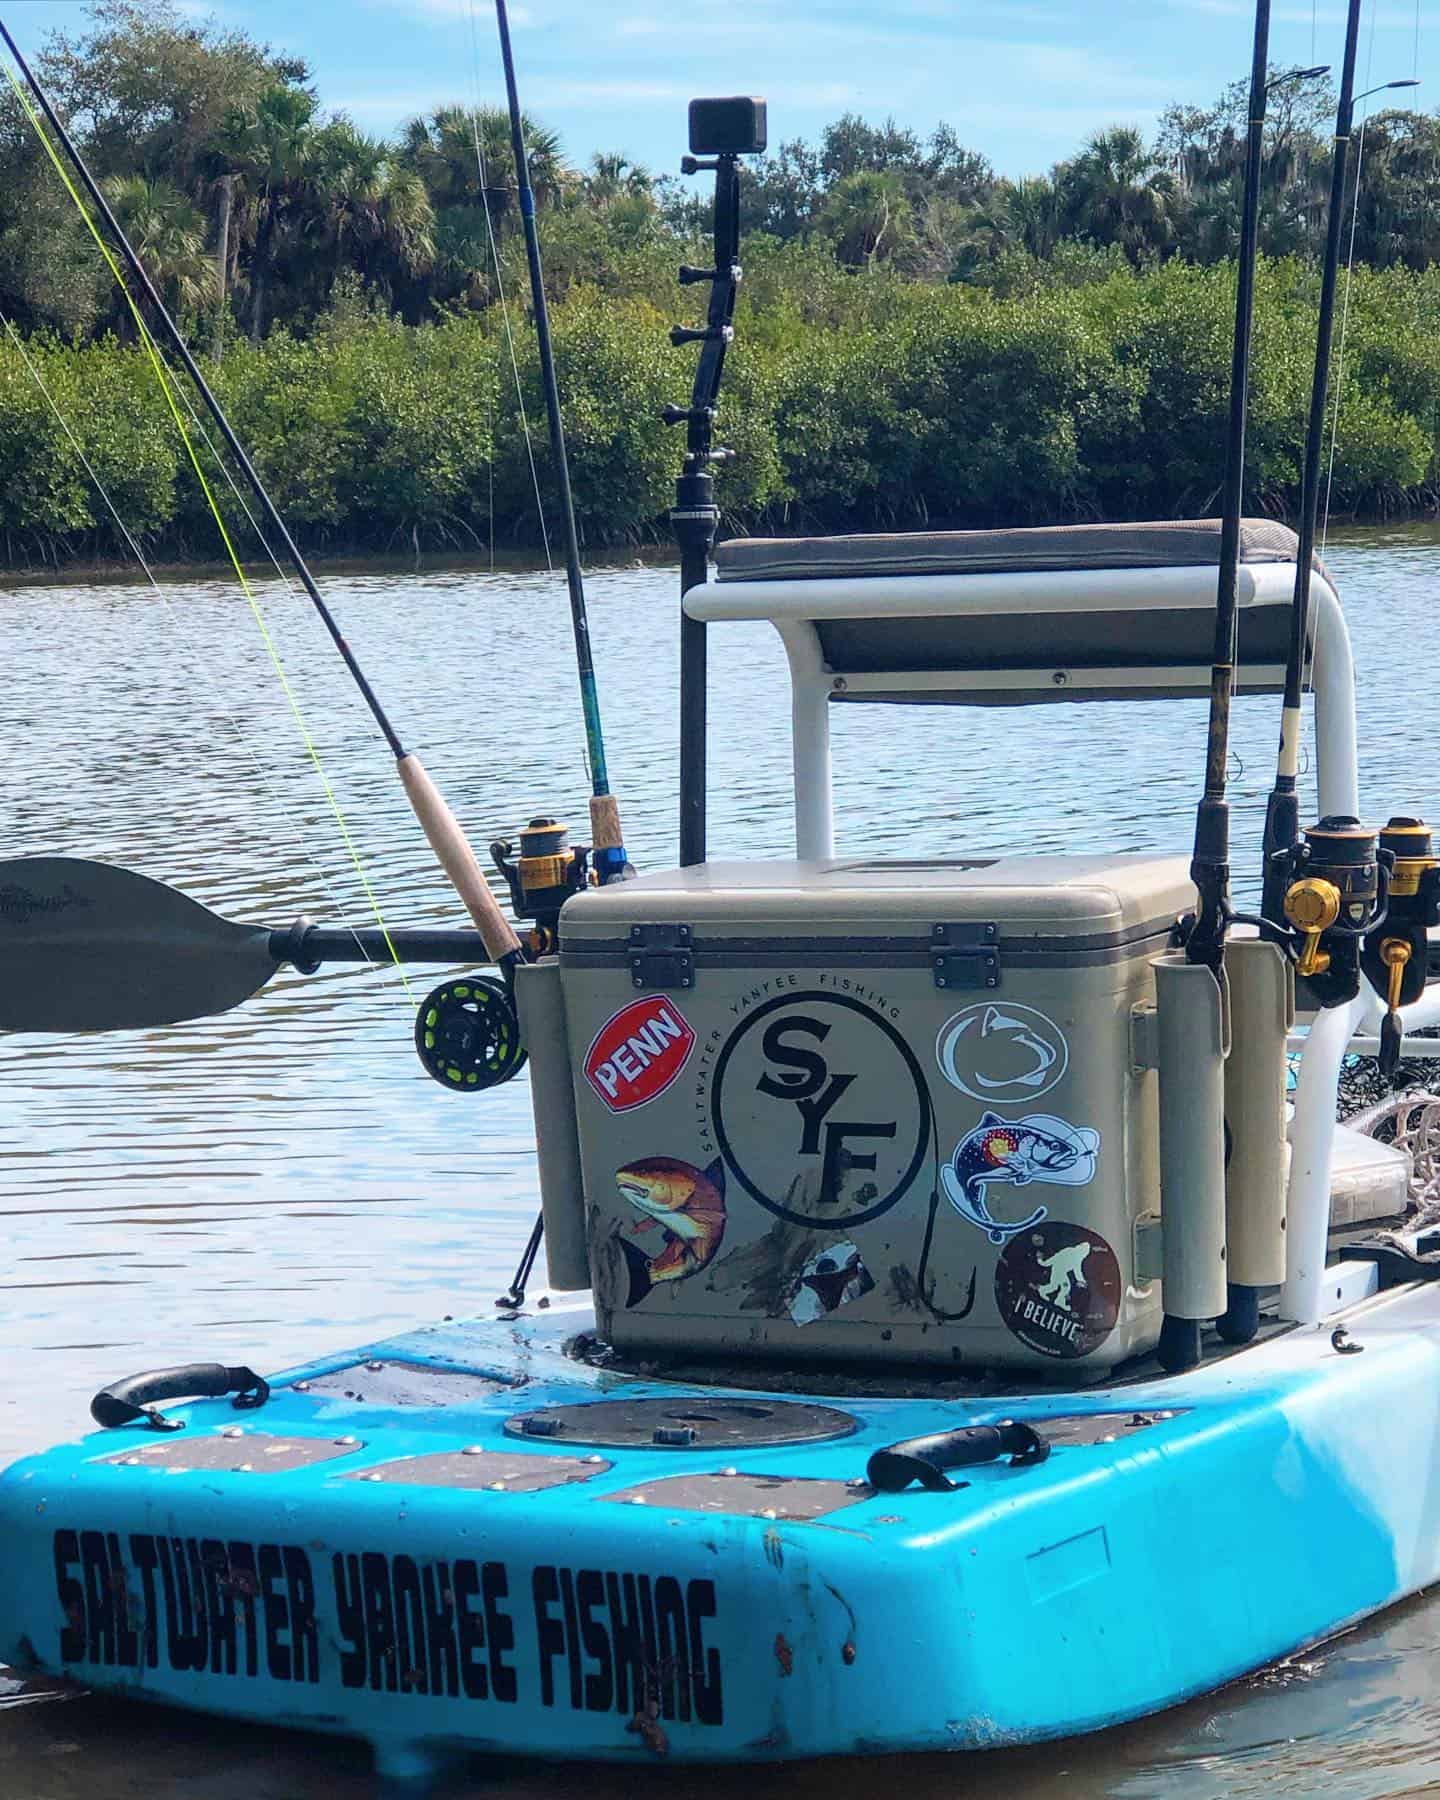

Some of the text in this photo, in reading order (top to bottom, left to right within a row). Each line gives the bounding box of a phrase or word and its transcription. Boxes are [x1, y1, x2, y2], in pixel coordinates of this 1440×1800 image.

[594, 1007, 683, 1099] PENN
[696, 1030, 721, 1153] SALTWATER
[820, 973, 901, 1019] FISHING
[54, 1529, 723, 1727] SALTWATER YANKEE FISHING
